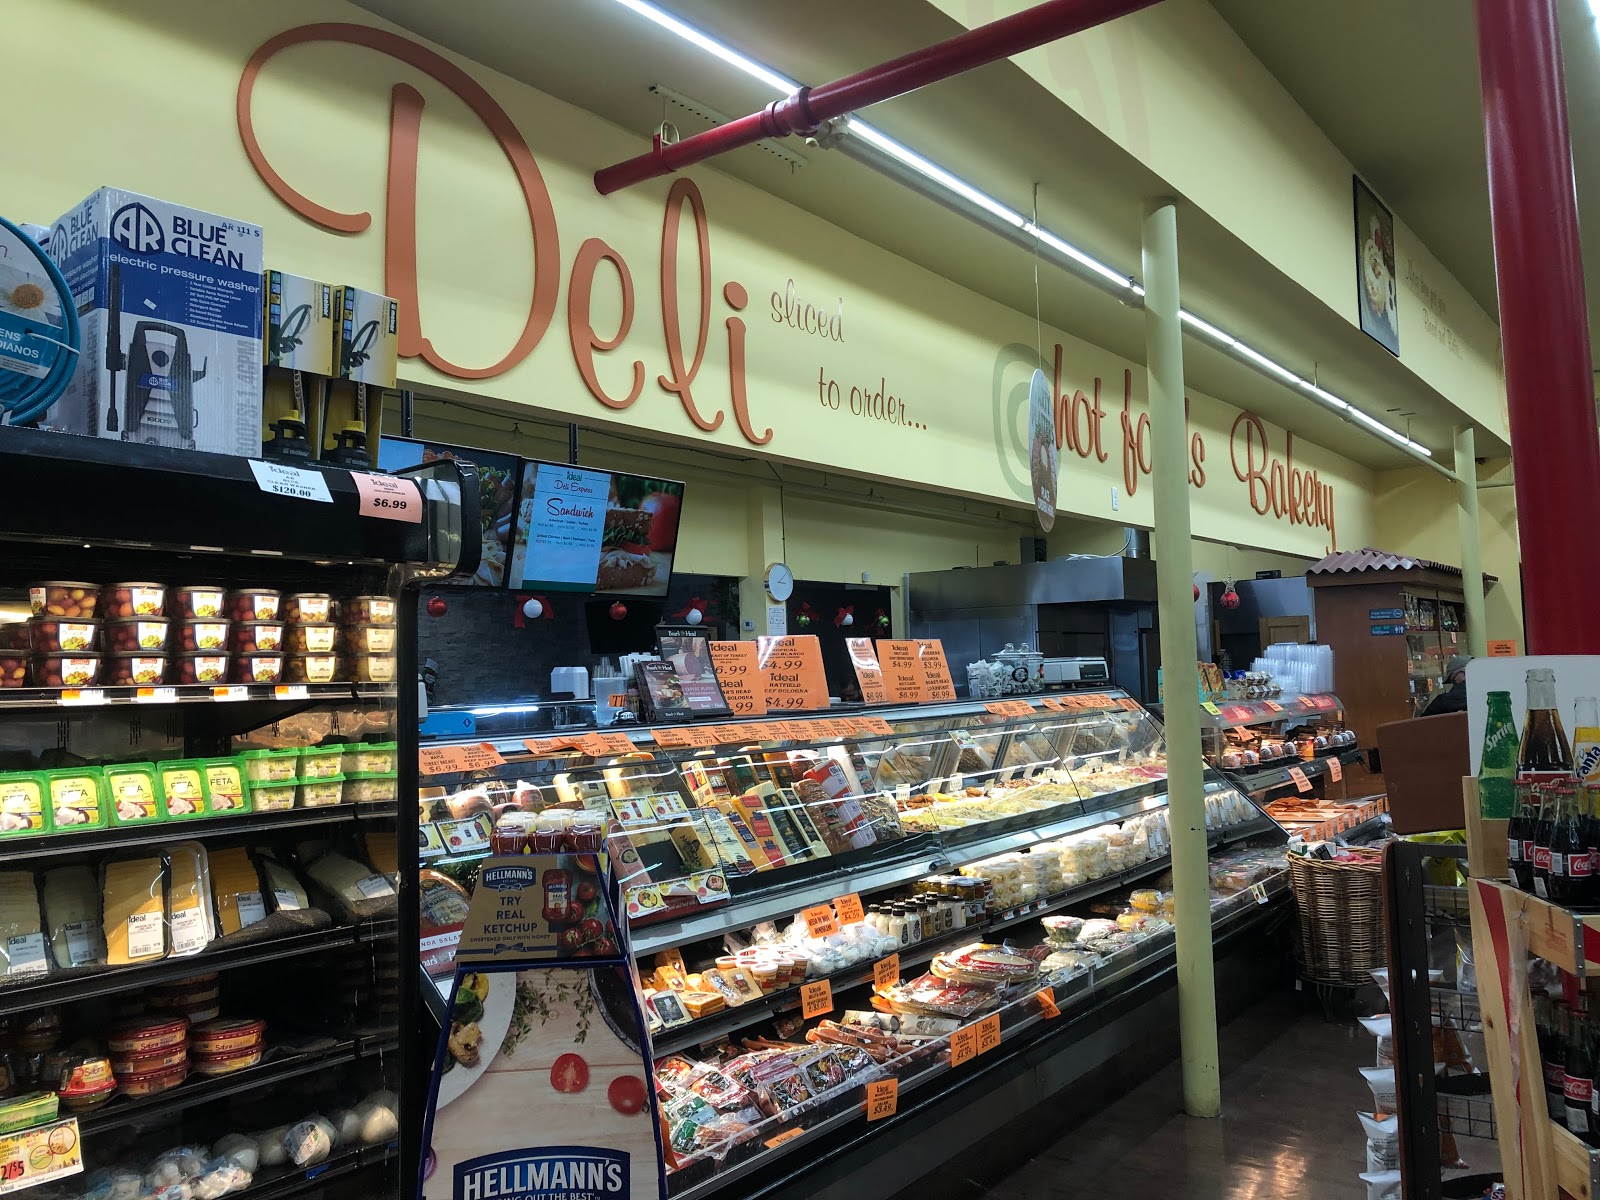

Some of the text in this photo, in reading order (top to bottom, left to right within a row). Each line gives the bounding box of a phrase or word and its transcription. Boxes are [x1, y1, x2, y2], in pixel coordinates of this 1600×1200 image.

[71, 205, 92, 235] BLUE
[112, 205, 162, 253] AR
[173, 215, 227, 246] BLUE
[237, 22, 773, 445] Deli
[70, 222, 99, 256] CLEAN
[171, 237, 243, 270] CLEAN
[110, 253, 260, 294] electric pressure washer
[771, 278, 845, 342] sliced
[0, 330, 21, 341] ENS
[818, 366, 927, 430] to order...
[1054, 344, 1206, 497] hot fos
[553, 480, 593, 493] Deli Express
[1230, 411, 1338, 556] Bakery
[272, 485, 311, 497] $120.00
[373, 498, 407, 510] $6.99
[547, 498, 594, 519] Sandwich
[715, 665, 747, 675] 6.99
[762, 660, 803, 670] $4.99
[720, 680, 743, 688] deal
[730, 702, 753, 712] .99
[765, 697, 804, 708] $4.99
[1486, 722, 1514, 752] Sprite
[429, 764, 458, 773] $6.99
[469, 760, 497, 768] $6.99
[171, 780, 193, 789] FA
[210, 777, 233, 786] FETA
[61, 789, 88, 798] FA
[119, 785, 143, 793] FA
[2, 794, 31, 803] FA
[486, 868, 533, 882] HELLMANN'S
[500, 897, 521, 906] TRY
[171, 911, 187, 919] deal
[496, 910, 525, 920] REAL
[483, 922, 538, 934] KETCHUP
[141, 1041, 159, 1050] Sabra
[215, 1043, 233, 1051] Sabra
[84, 1066, 104, 1077] Sabra
[1, 1161, 24, 1180] 2/$5
[464, 1160, 622, 1200] HELLMANN'S
